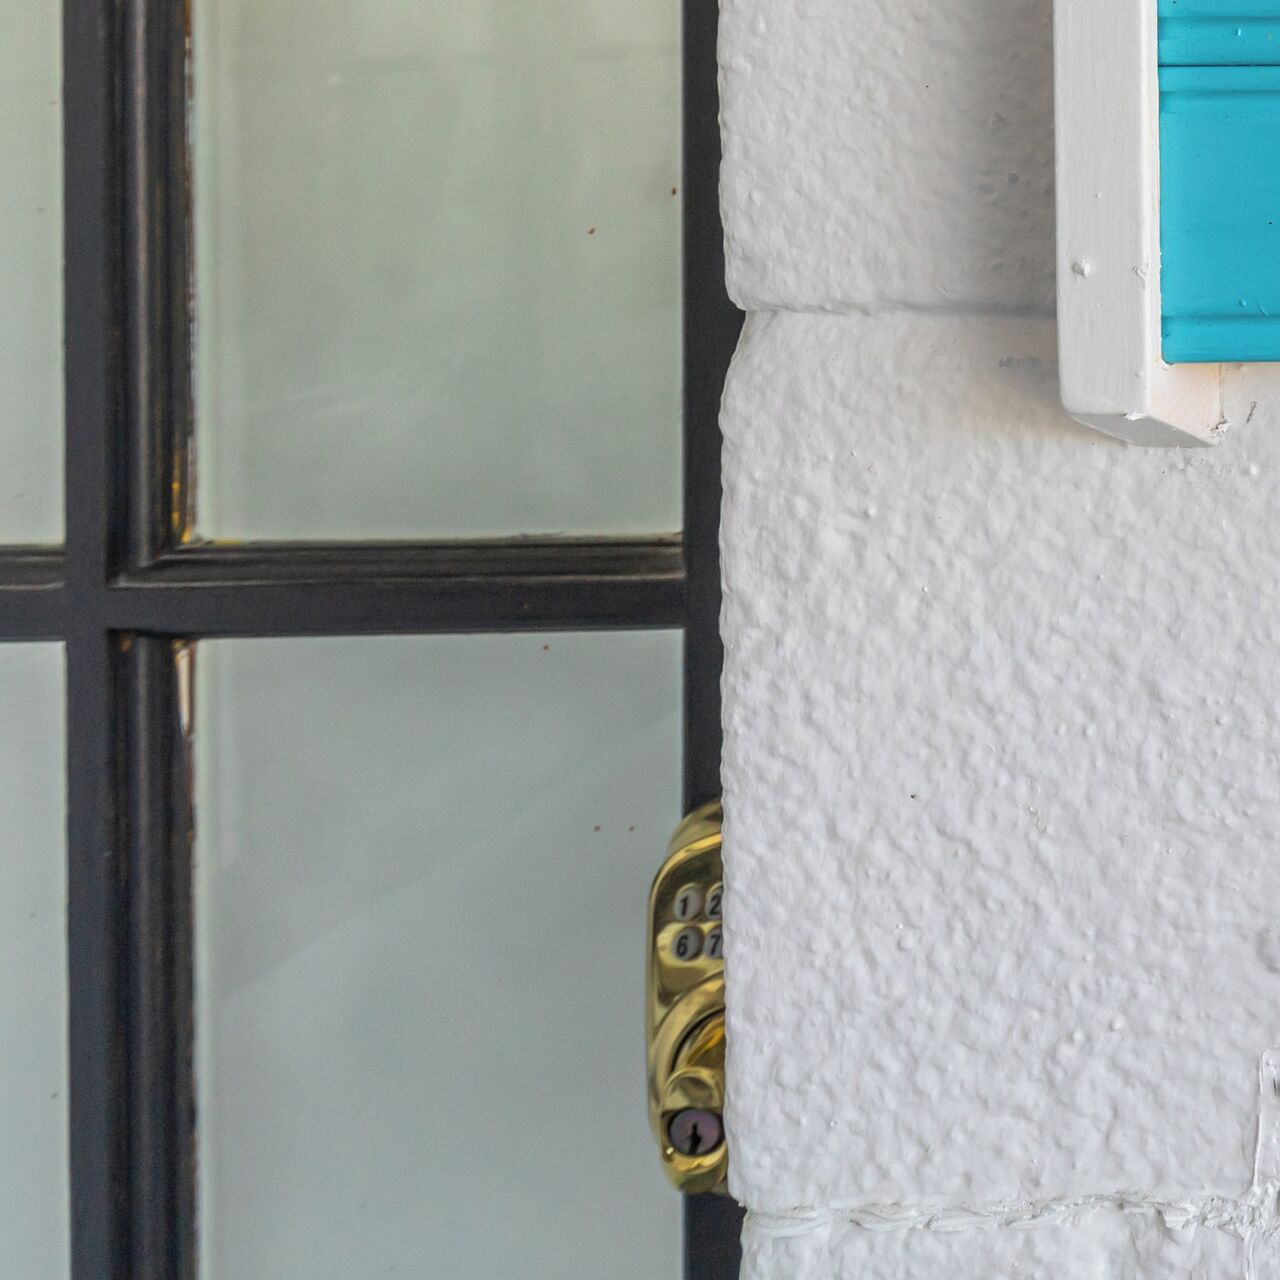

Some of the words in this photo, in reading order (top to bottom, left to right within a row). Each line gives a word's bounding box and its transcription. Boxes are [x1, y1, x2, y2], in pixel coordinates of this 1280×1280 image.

[680, 895, 689, 917] 1
[676, 933, 690, 957] 6
[710, 934, 722, 956] 7
